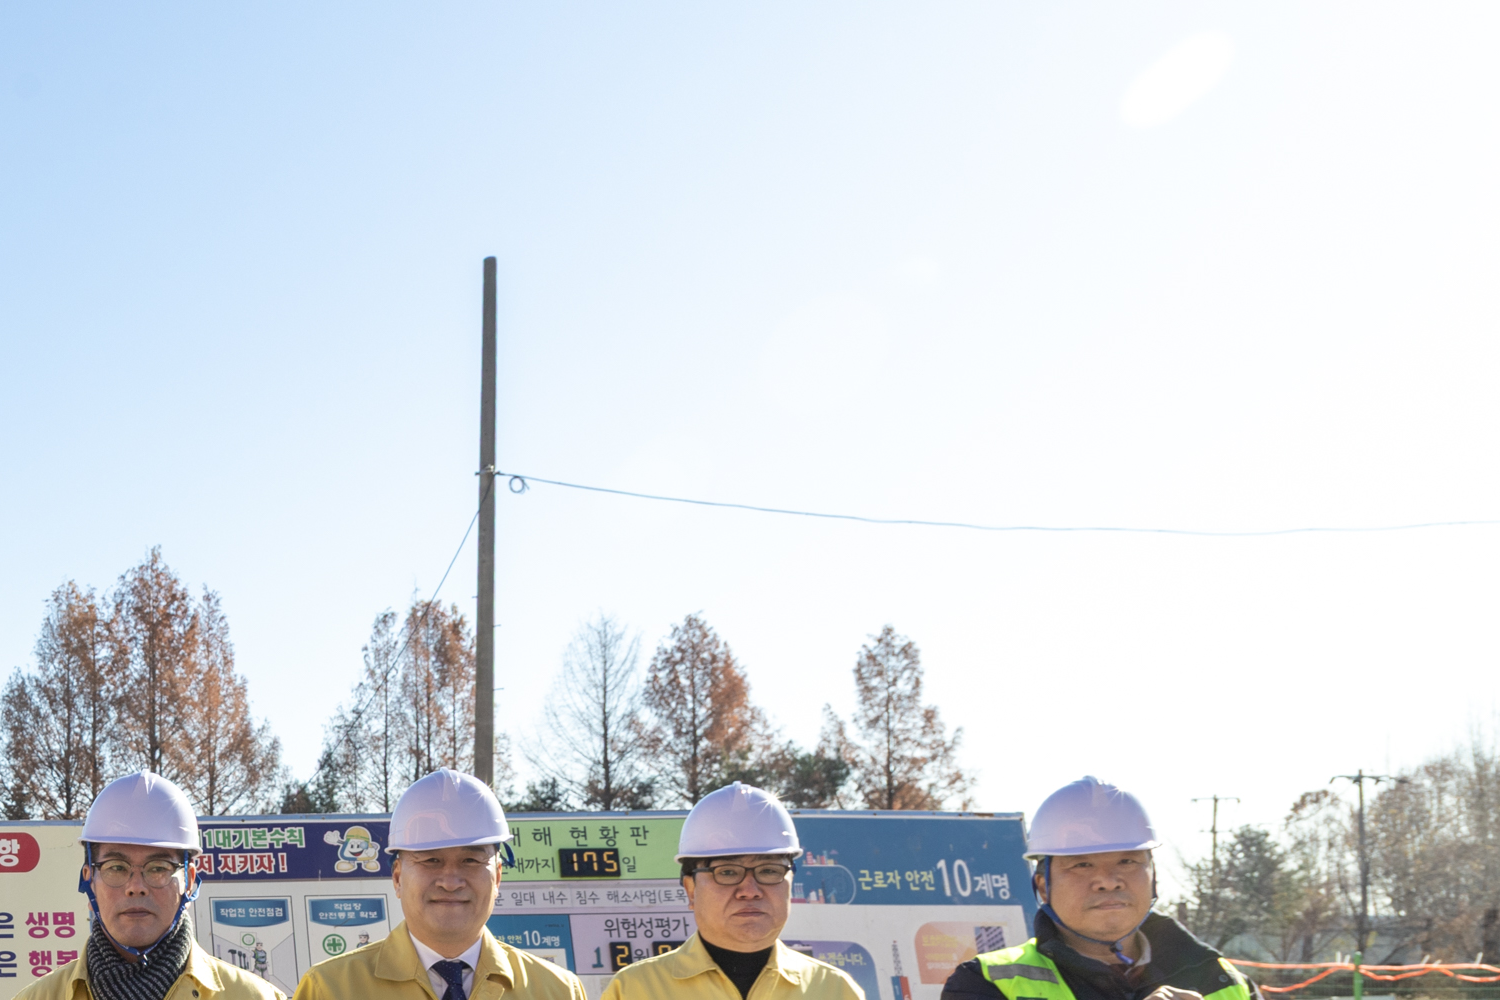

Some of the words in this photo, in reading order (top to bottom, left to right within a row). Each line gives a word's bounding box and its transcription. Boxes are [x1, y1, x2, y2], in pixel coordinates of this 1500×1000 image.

[218, 853, 276, 875] 지키자
[572, 851, 618, 873] 175
[622, 856, 637, 873] 일
[858, 869, 901, 891] 근로자
[905, 870, 936, 892] 안전
[511, 891, 536, 907] 일대
[542, 890, 568, 906] 내수
[576, 890, 600, 905] 침수
[219, 907, 246, 918] 작업전
[249, 907, 284, 918] 안전점검
[25, 911, 77, 939] 생명
[603, 916, 690, 939] 위험성평가
